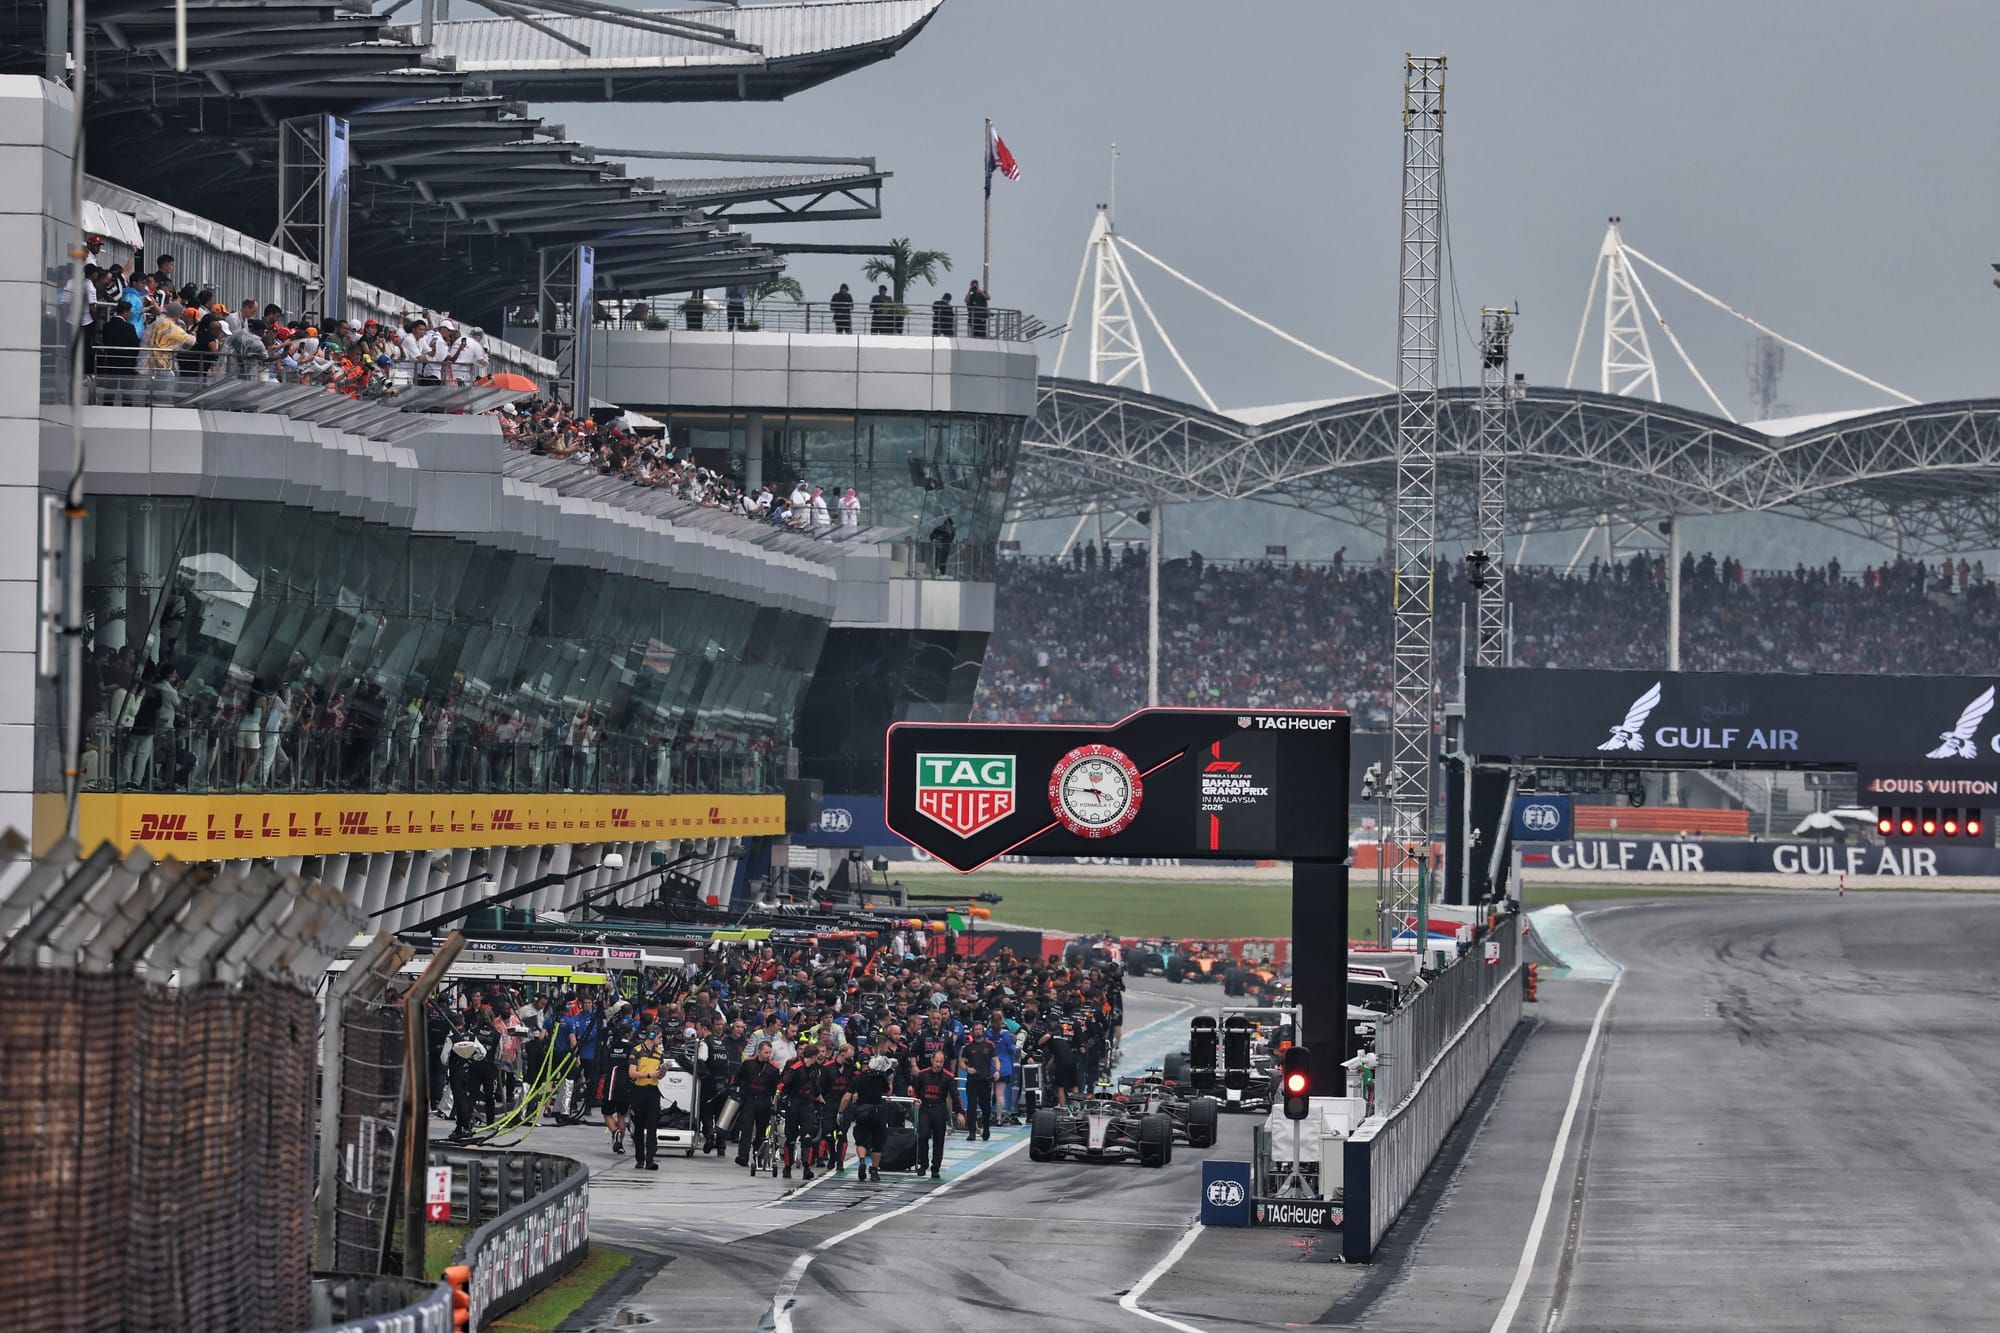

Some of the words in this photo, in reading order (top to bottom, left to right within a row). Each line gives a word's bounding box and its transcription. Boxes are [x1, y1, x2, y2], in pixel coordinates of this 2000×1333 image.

[1655, 727, 1740, 749] GULF
[1747, 728, 1799, 750] AIR
[925, 760, 1006, 785] TAG
[1202, 779, 1250, 787] BAHRAIN
[1202, 787, 1241, 795] GRAND
[1242, 787, 1268, 796] PRIX
[1875, 779, 1924, 793] LOUIS
[1927, 780, 1998, 794] VUITTON
[339, 811, 371, 835] HL
[923, 793, 1009, 831] HEUER
[136, 814, 190, 840] DHL
[1552, 842, 1637, 870] GULF
[1646, 843, 1705, 872] AIR
[1772, 845, 1866, 875] GULF
[1877, 847, 1939, 877] AIR
